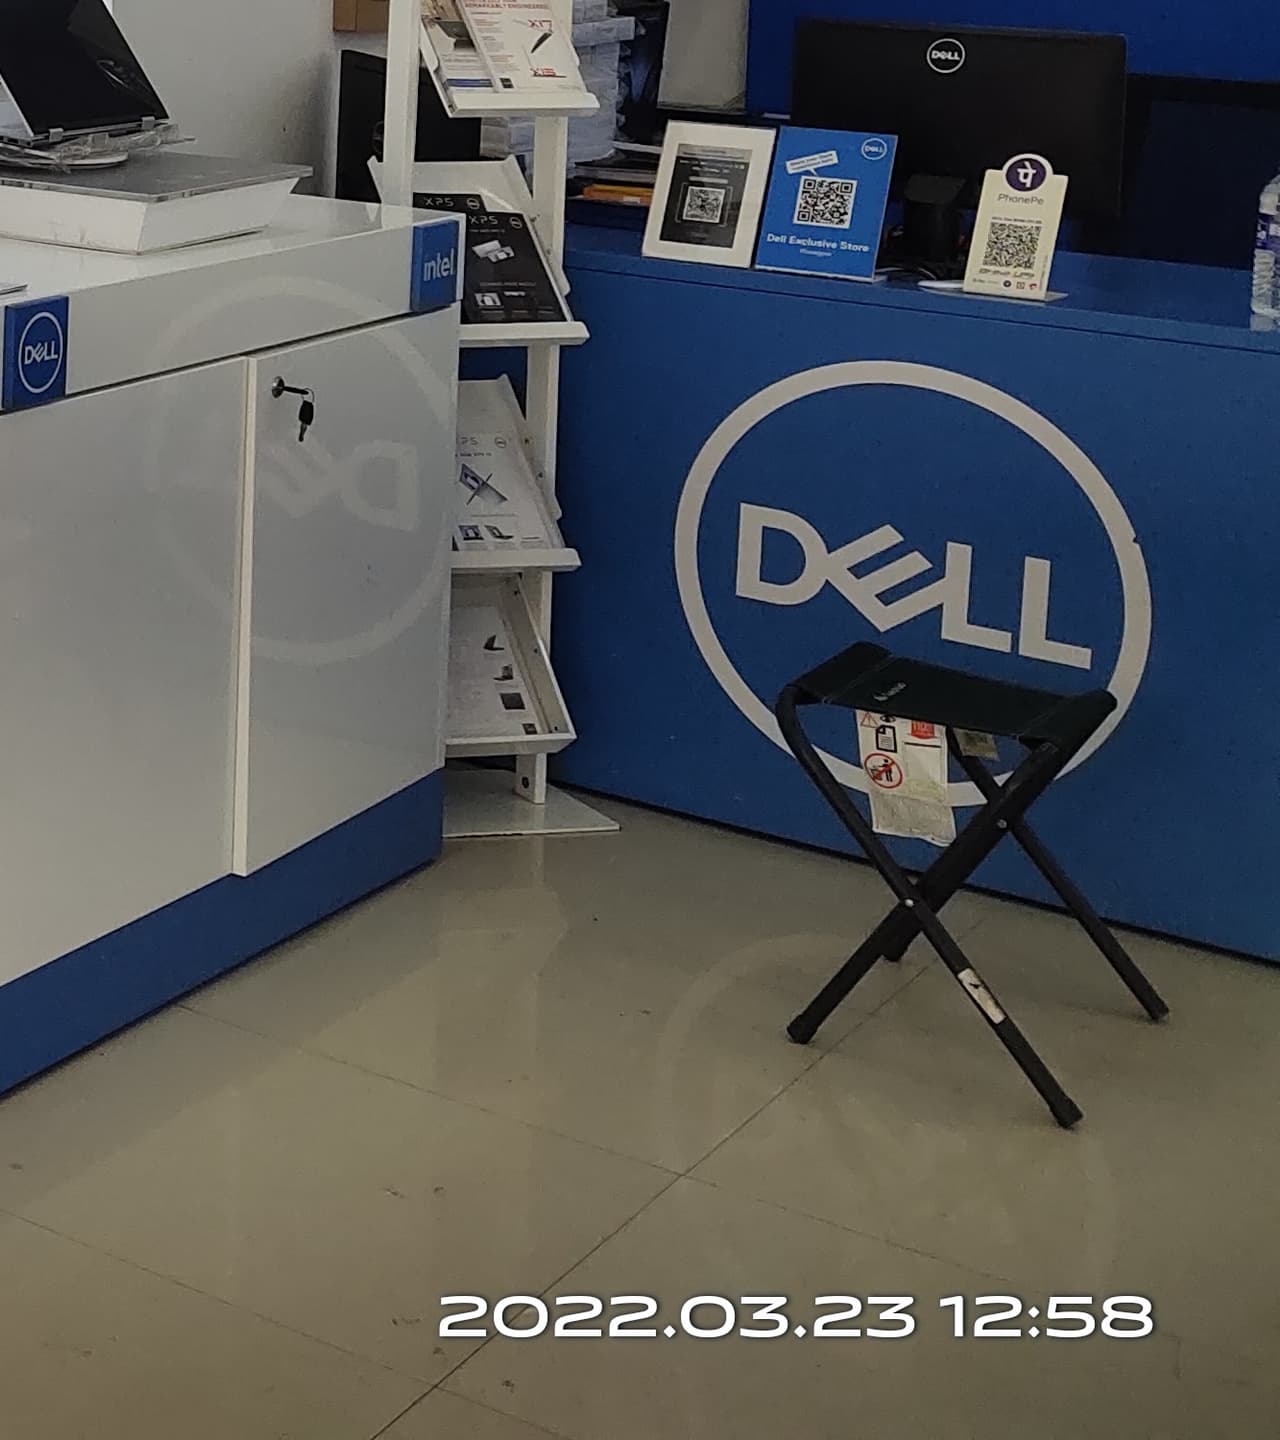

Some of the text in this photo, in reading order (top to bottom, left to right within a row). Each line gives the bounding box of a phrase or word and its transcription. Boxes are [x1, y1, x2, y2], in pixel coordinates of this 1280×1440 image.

[469, 215, 499, 225] XPS
[767, 233, 786, 244] Dell
[789, 235, 837, 249] Exclusive
[24, 340, 58, 365] DELL
[735, 501, 1092, 671] DELL
